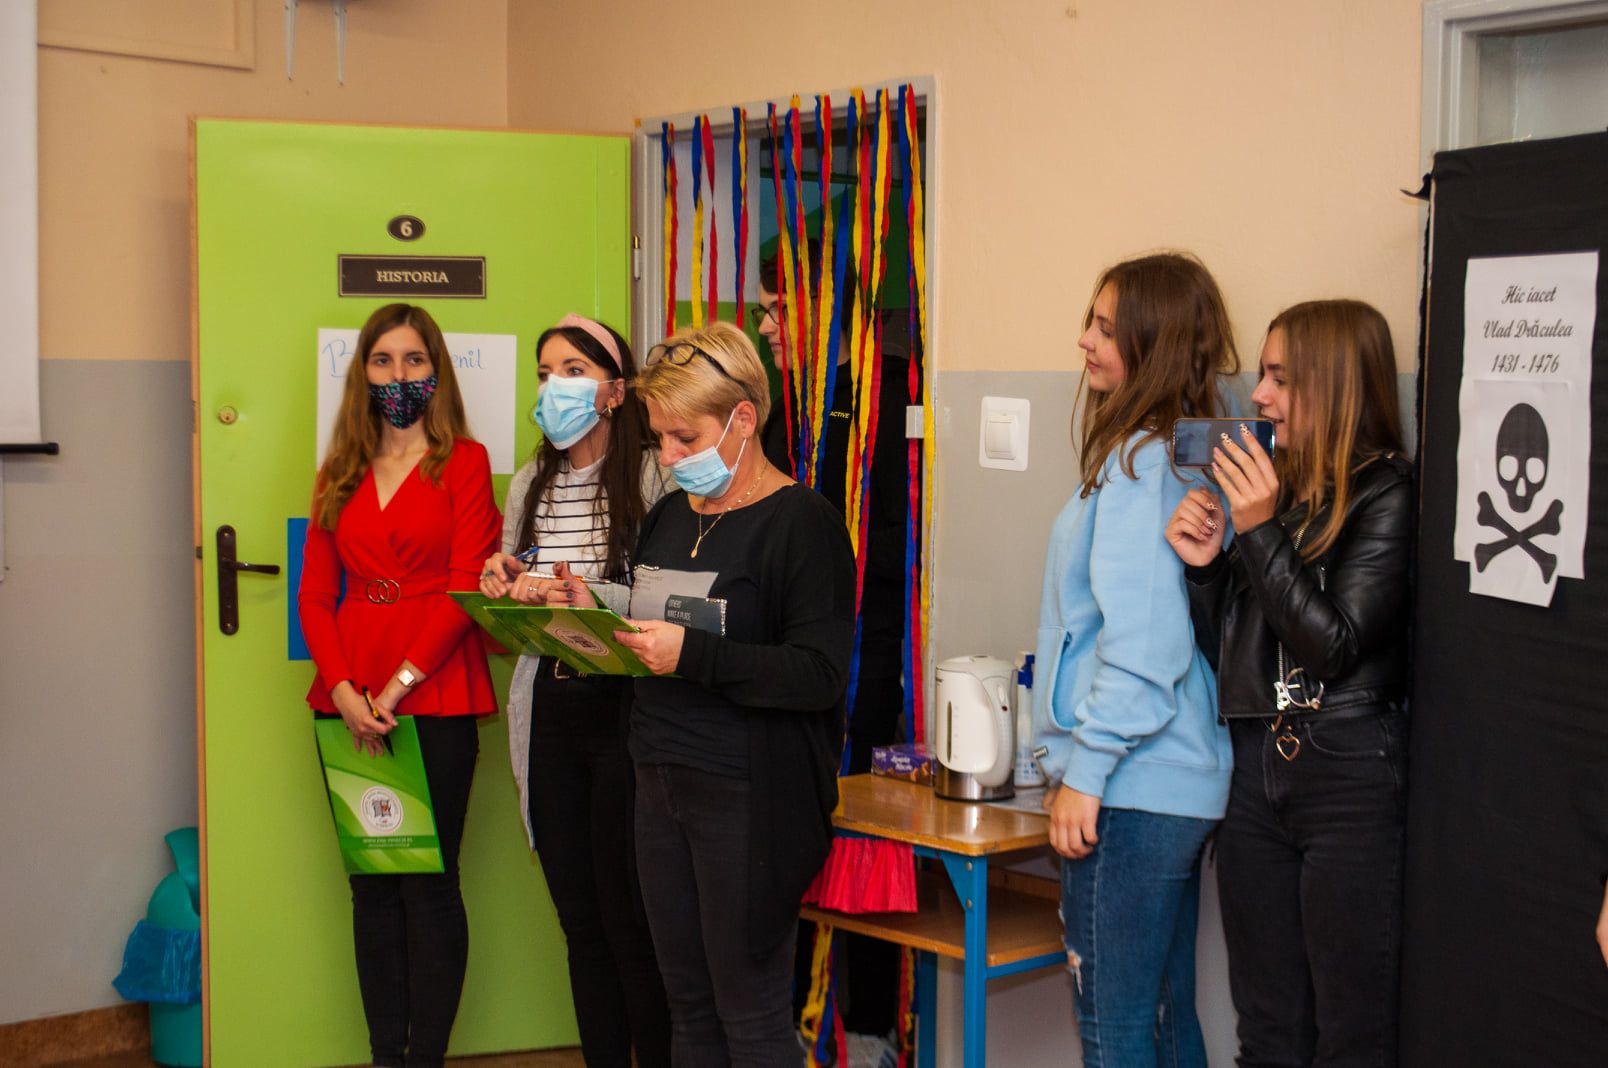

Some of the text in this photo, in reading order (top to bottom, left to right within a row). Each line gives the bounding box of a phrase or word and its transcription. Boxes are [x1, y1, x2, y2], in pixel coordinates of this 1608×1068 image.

[400, 221, 413, 237] 6
[376, 270, 449, 283] HISTORIA
[1501, 285, 1557, 304] Hic iacet
[1484, 319, 1514, 338] Vlad
[1491, 354, 1520, 373] 1431
[1528, 354, 1560, 373] 1476
